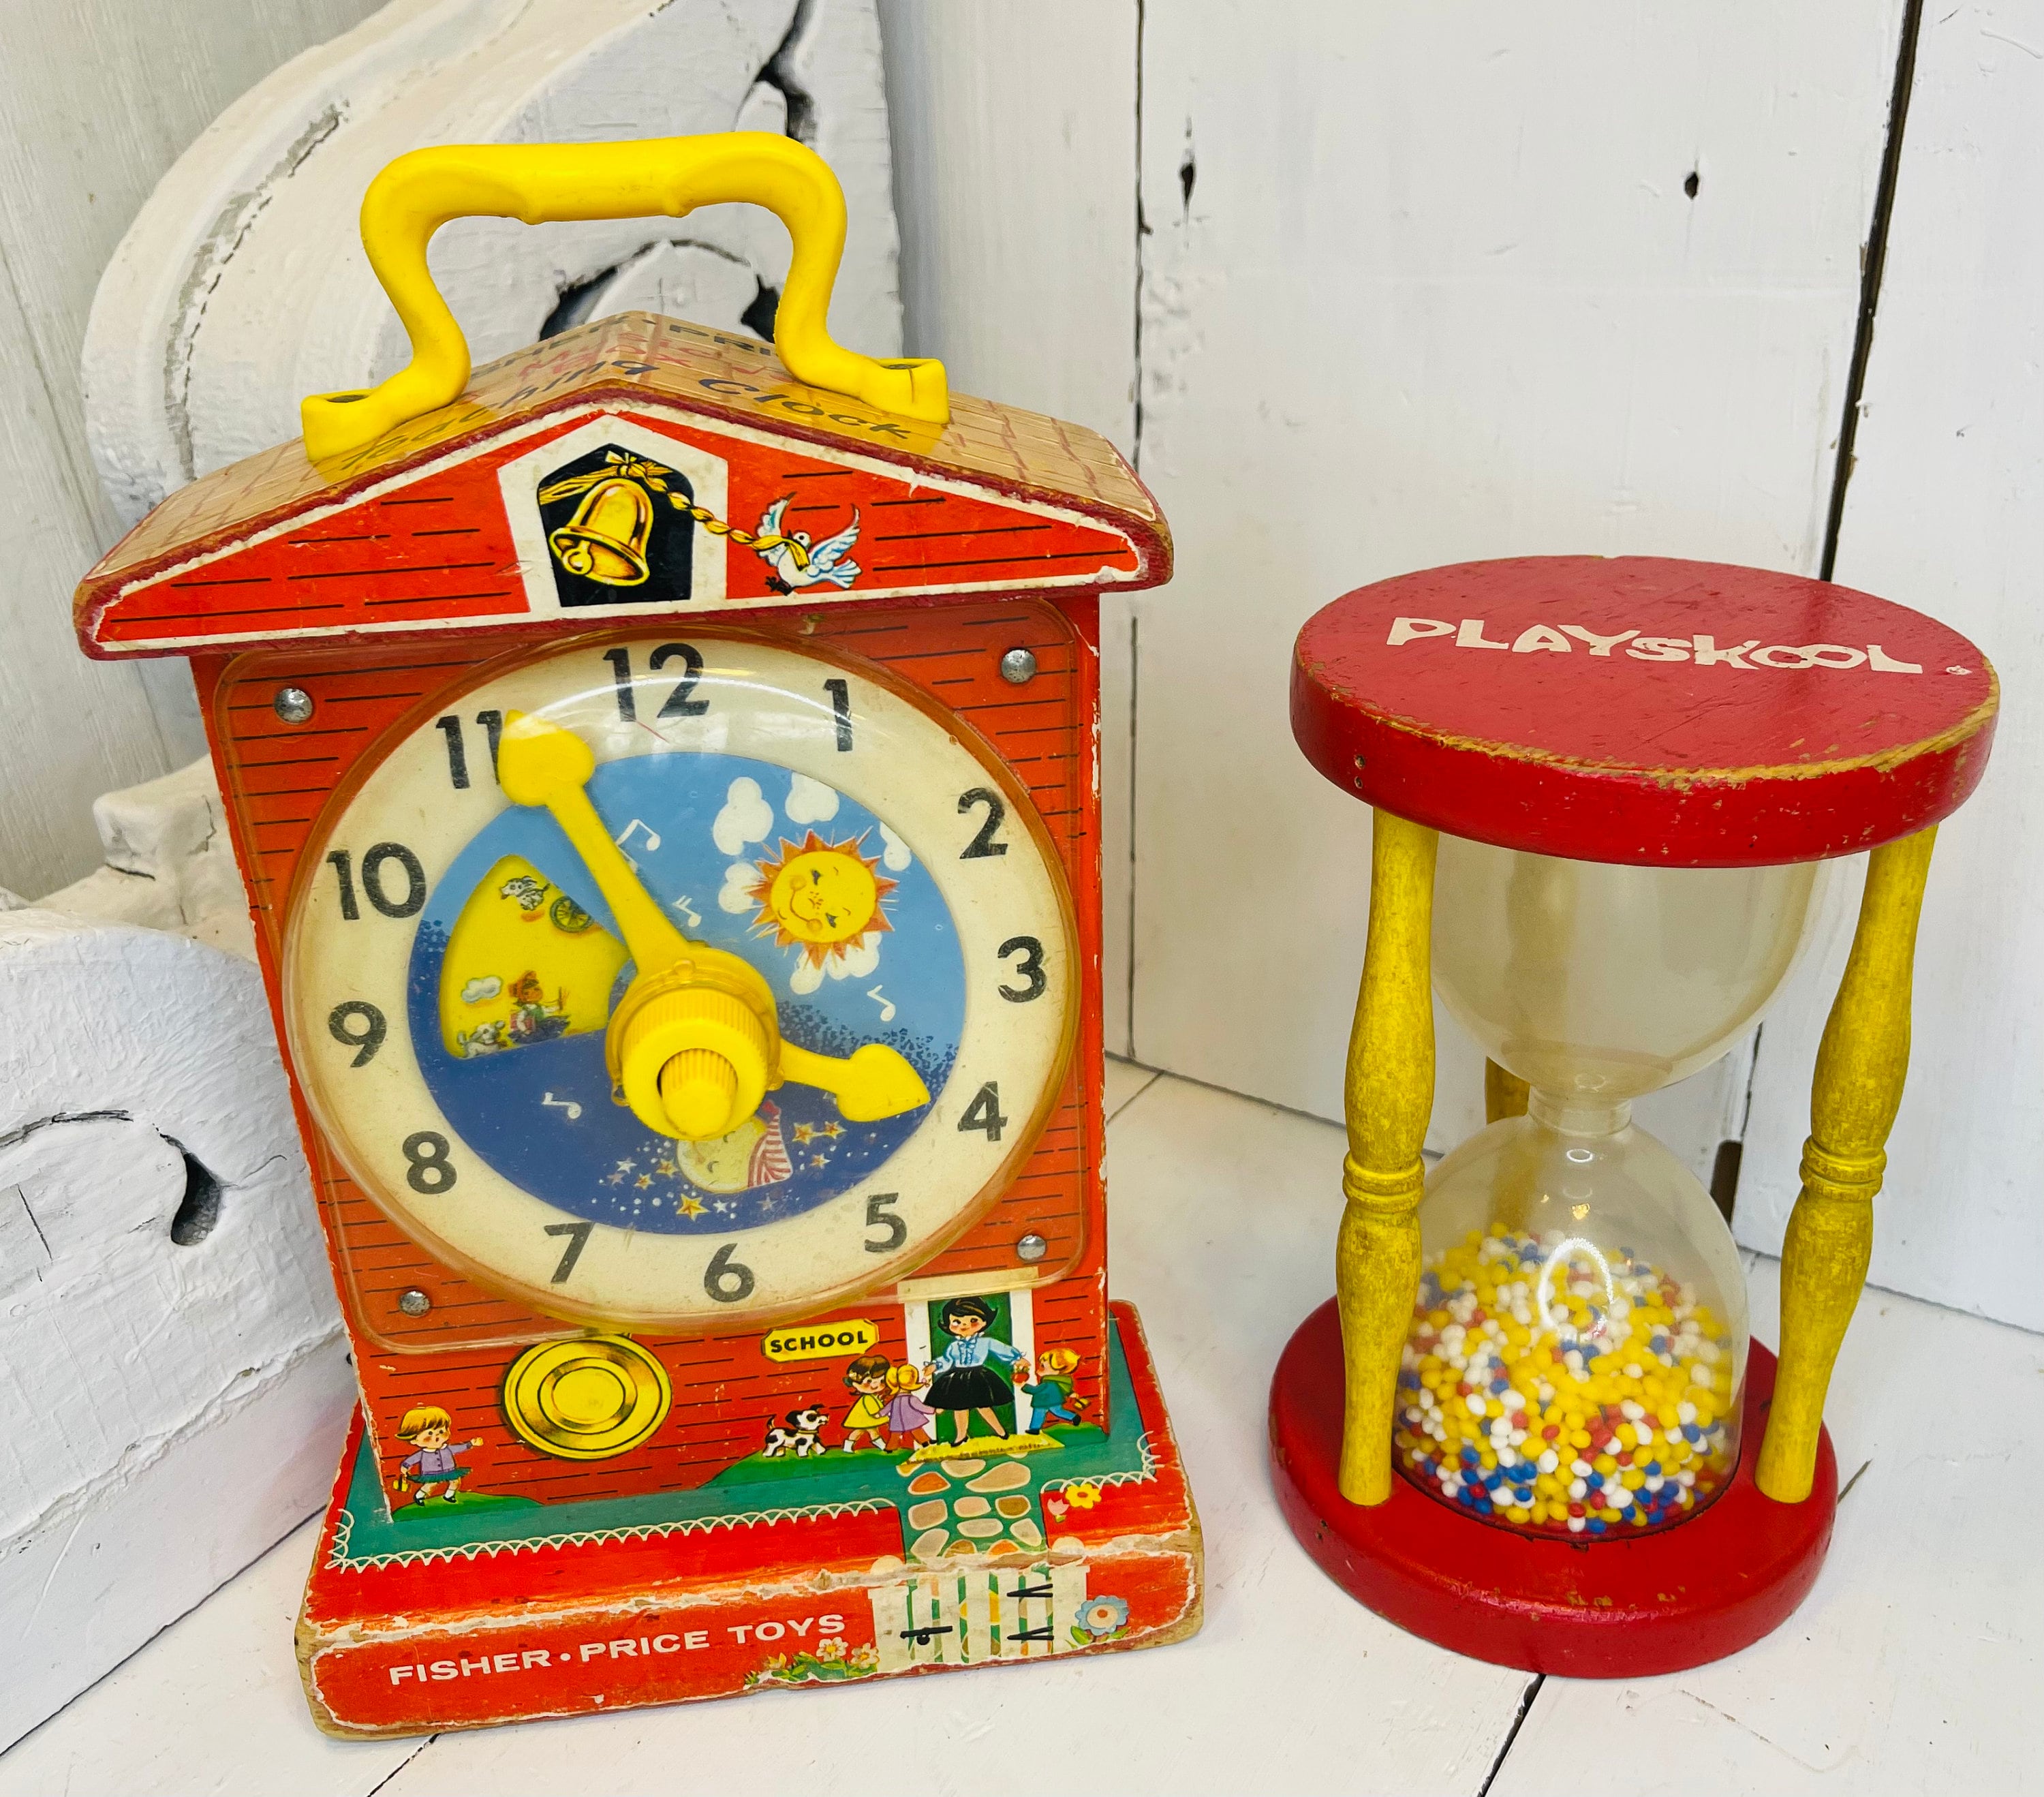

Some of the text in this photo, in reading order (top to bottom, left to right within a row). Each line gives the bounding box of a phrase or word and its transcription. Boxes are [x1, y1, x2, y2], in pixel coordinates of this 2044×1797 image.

[698, 378, 912, 440] Clock
[1385, 616, 1923, 674] PLAYSKOOL
[602, 642, 710, 722] 12
[822, 678, 854, 752] 1
[435, 709, 504, 790] 11
[957, 786, 1009, 860] 2
[326, 841, 427, 921] 10
[996, 936, 1048, 1003] 3
[328, 1000, 388, 1068] 9
[957, 1081, 1008, 1142] 4
[401, 1131, 458, 1195] 8
[543, 1221, 595, 1285] 7
[864, 1192, 908, 1253] 5
[703, 1243, 756, 1303] 6
[770, 1330, 869, 1353] SCHOOL
[727, 1613, 847, 1645] TOYS
